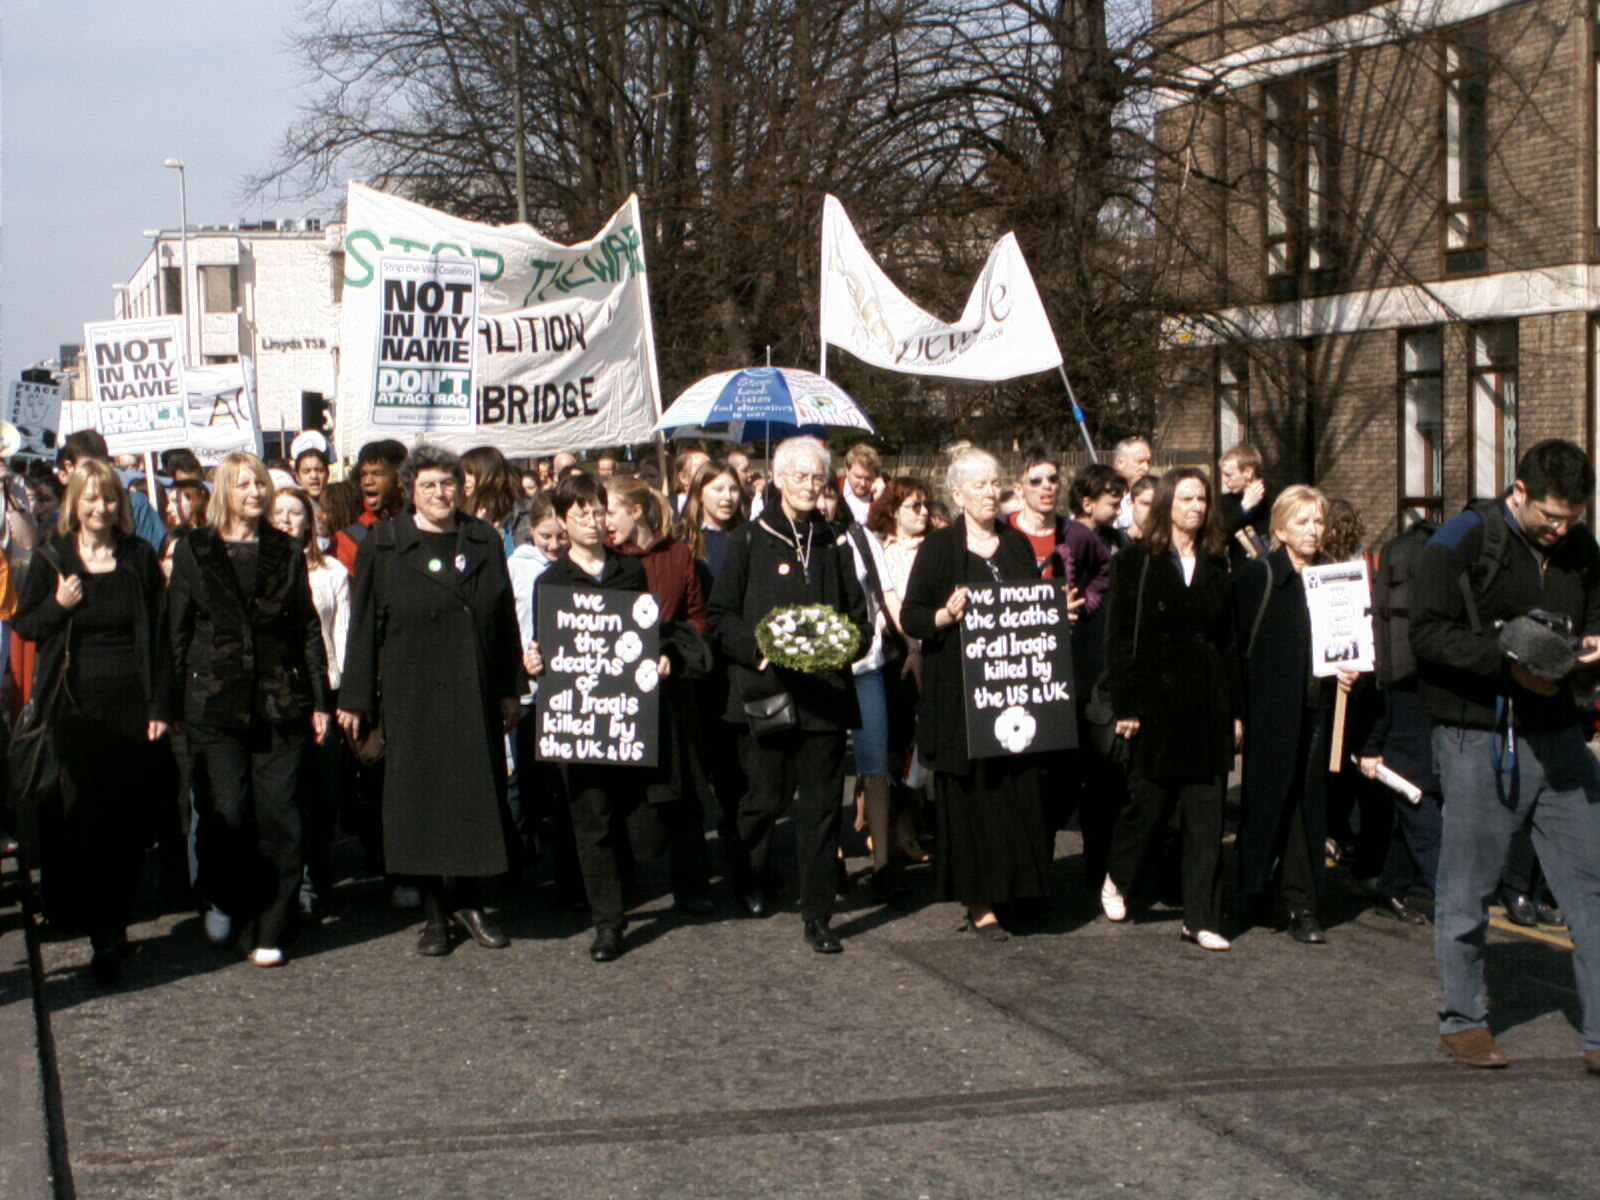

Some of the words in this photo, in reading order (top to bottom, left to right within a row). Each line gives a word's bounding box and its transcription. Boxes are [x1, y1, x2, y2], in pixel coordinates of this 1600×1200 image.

[384, 279, 472, 315] NOT
[383, 314, 414, 337] IN
[423, 316, 470, 339] MY
[95, 337, 173, 366] NOT
[381, 338, 470, 363] NAME
[97, 366, 125, 385] IN
[133, 362, 175, 380] MY
[378, 369, 470, 395] DON'T
[100, 379, 180, 402] NAME
[377, 392, 431, 406] ATTACK
[433, 394, 469, 408] IRAQ
[102, 402, 184, 426] DON'T
[572, 592, 606, 612] we
[967, 588, 995, 606] we
[1000, 584, 1055, 604] mourn
[557, 609, 622, 632] mourn
[964, 608, 996, 631] the
[999, 603, 1060, 628] deaths
[574, 631, 610, 655] the
[965, 636, 986, 659] of
[986, 634, 1008, 658] all
[1009, 631, 1057, 661] Iraqis
[550, 646, 625, 676] deaths
[984, 656, 1028, 681] killed
[1031, 655, 1053, 683] by
[575, 674, 600, 692] of
[974, 686, 1006, 709] the
[1006, 684, 1029, 706] US
[1032, 687, 1043, 704] &
[1043, 681, 1070, 703] UK
[549, 689, 573, 711] all
[580, 690, 639, 721] Iraqis
[543, 711, 595, 736] killed
[609, 715, 636, 743] by
[539, 733, 573, 759] the
[576, 739, 605, 759] UK
[607, 744, 618, 761] &
[619, 741, 645, 762] US
